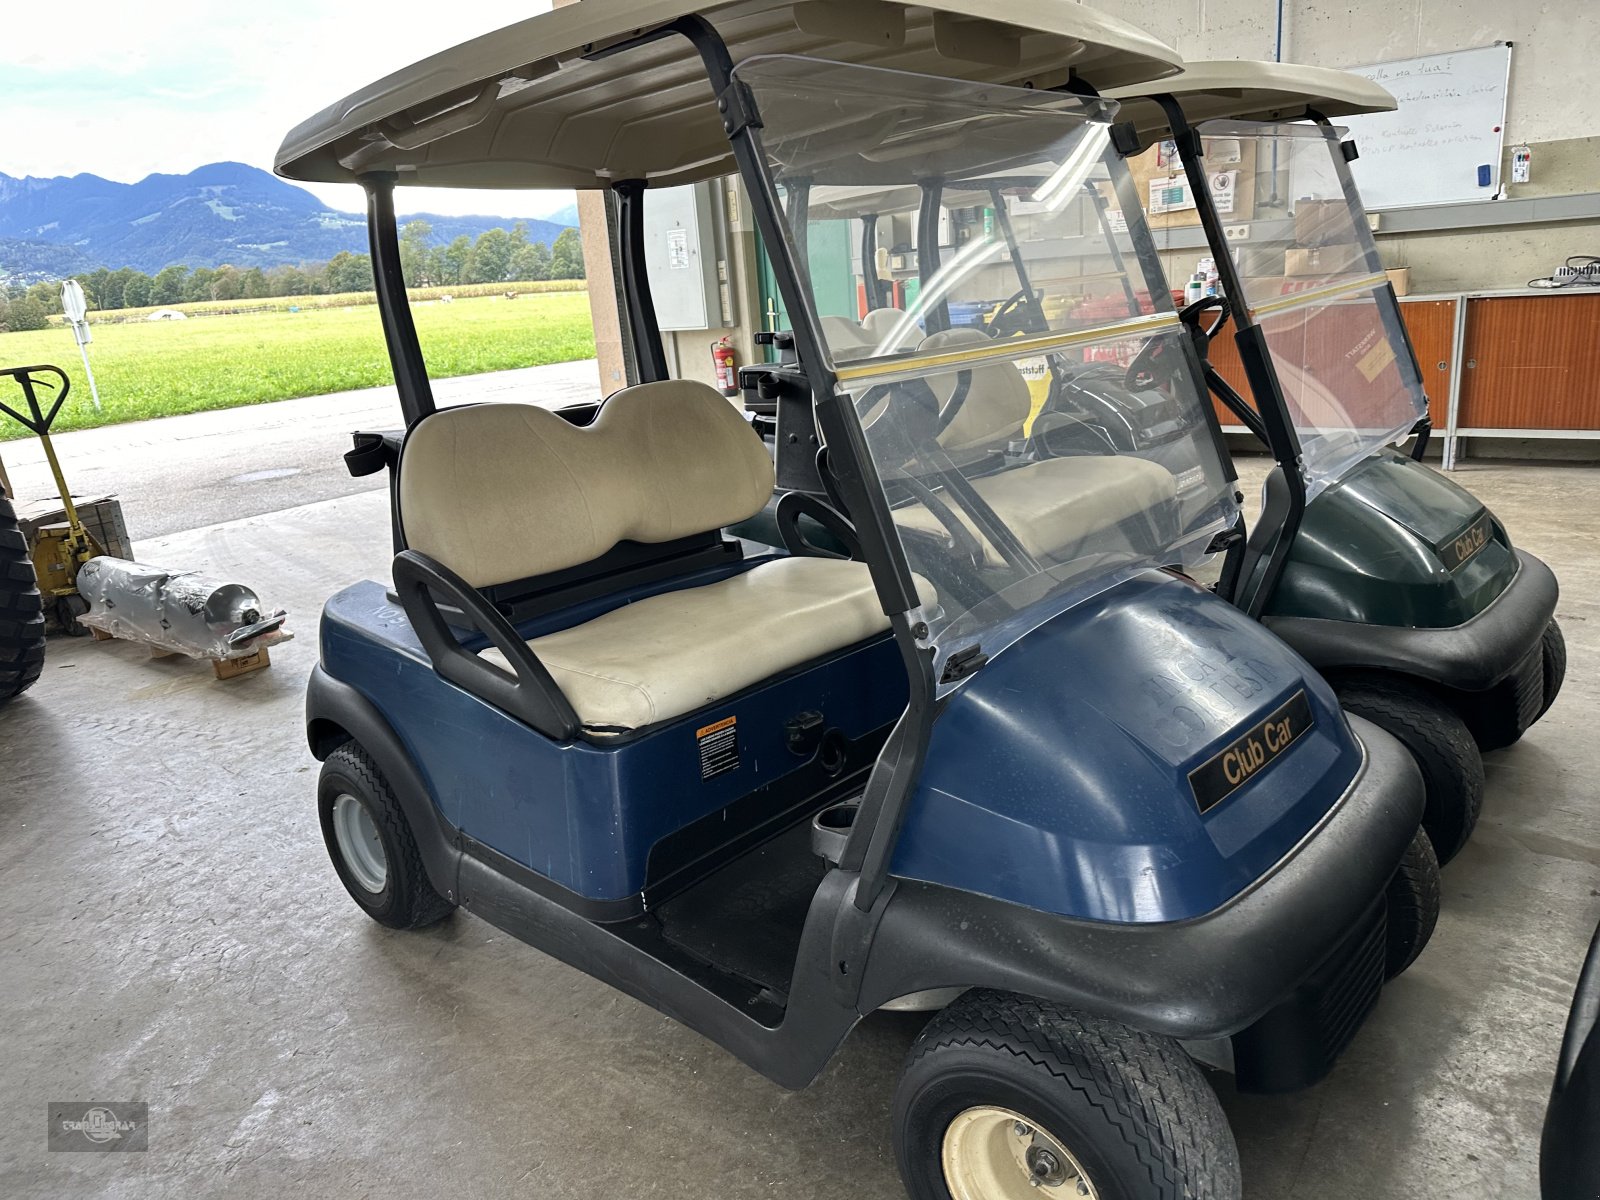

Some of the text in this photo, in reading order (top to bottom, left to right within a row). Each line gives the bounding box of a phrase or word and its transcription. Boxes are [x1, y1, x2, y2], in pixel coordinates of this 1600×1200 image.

[1455, 526, 1485, 561] Club Car
[1223, 715, 1293, 786] Club Car
